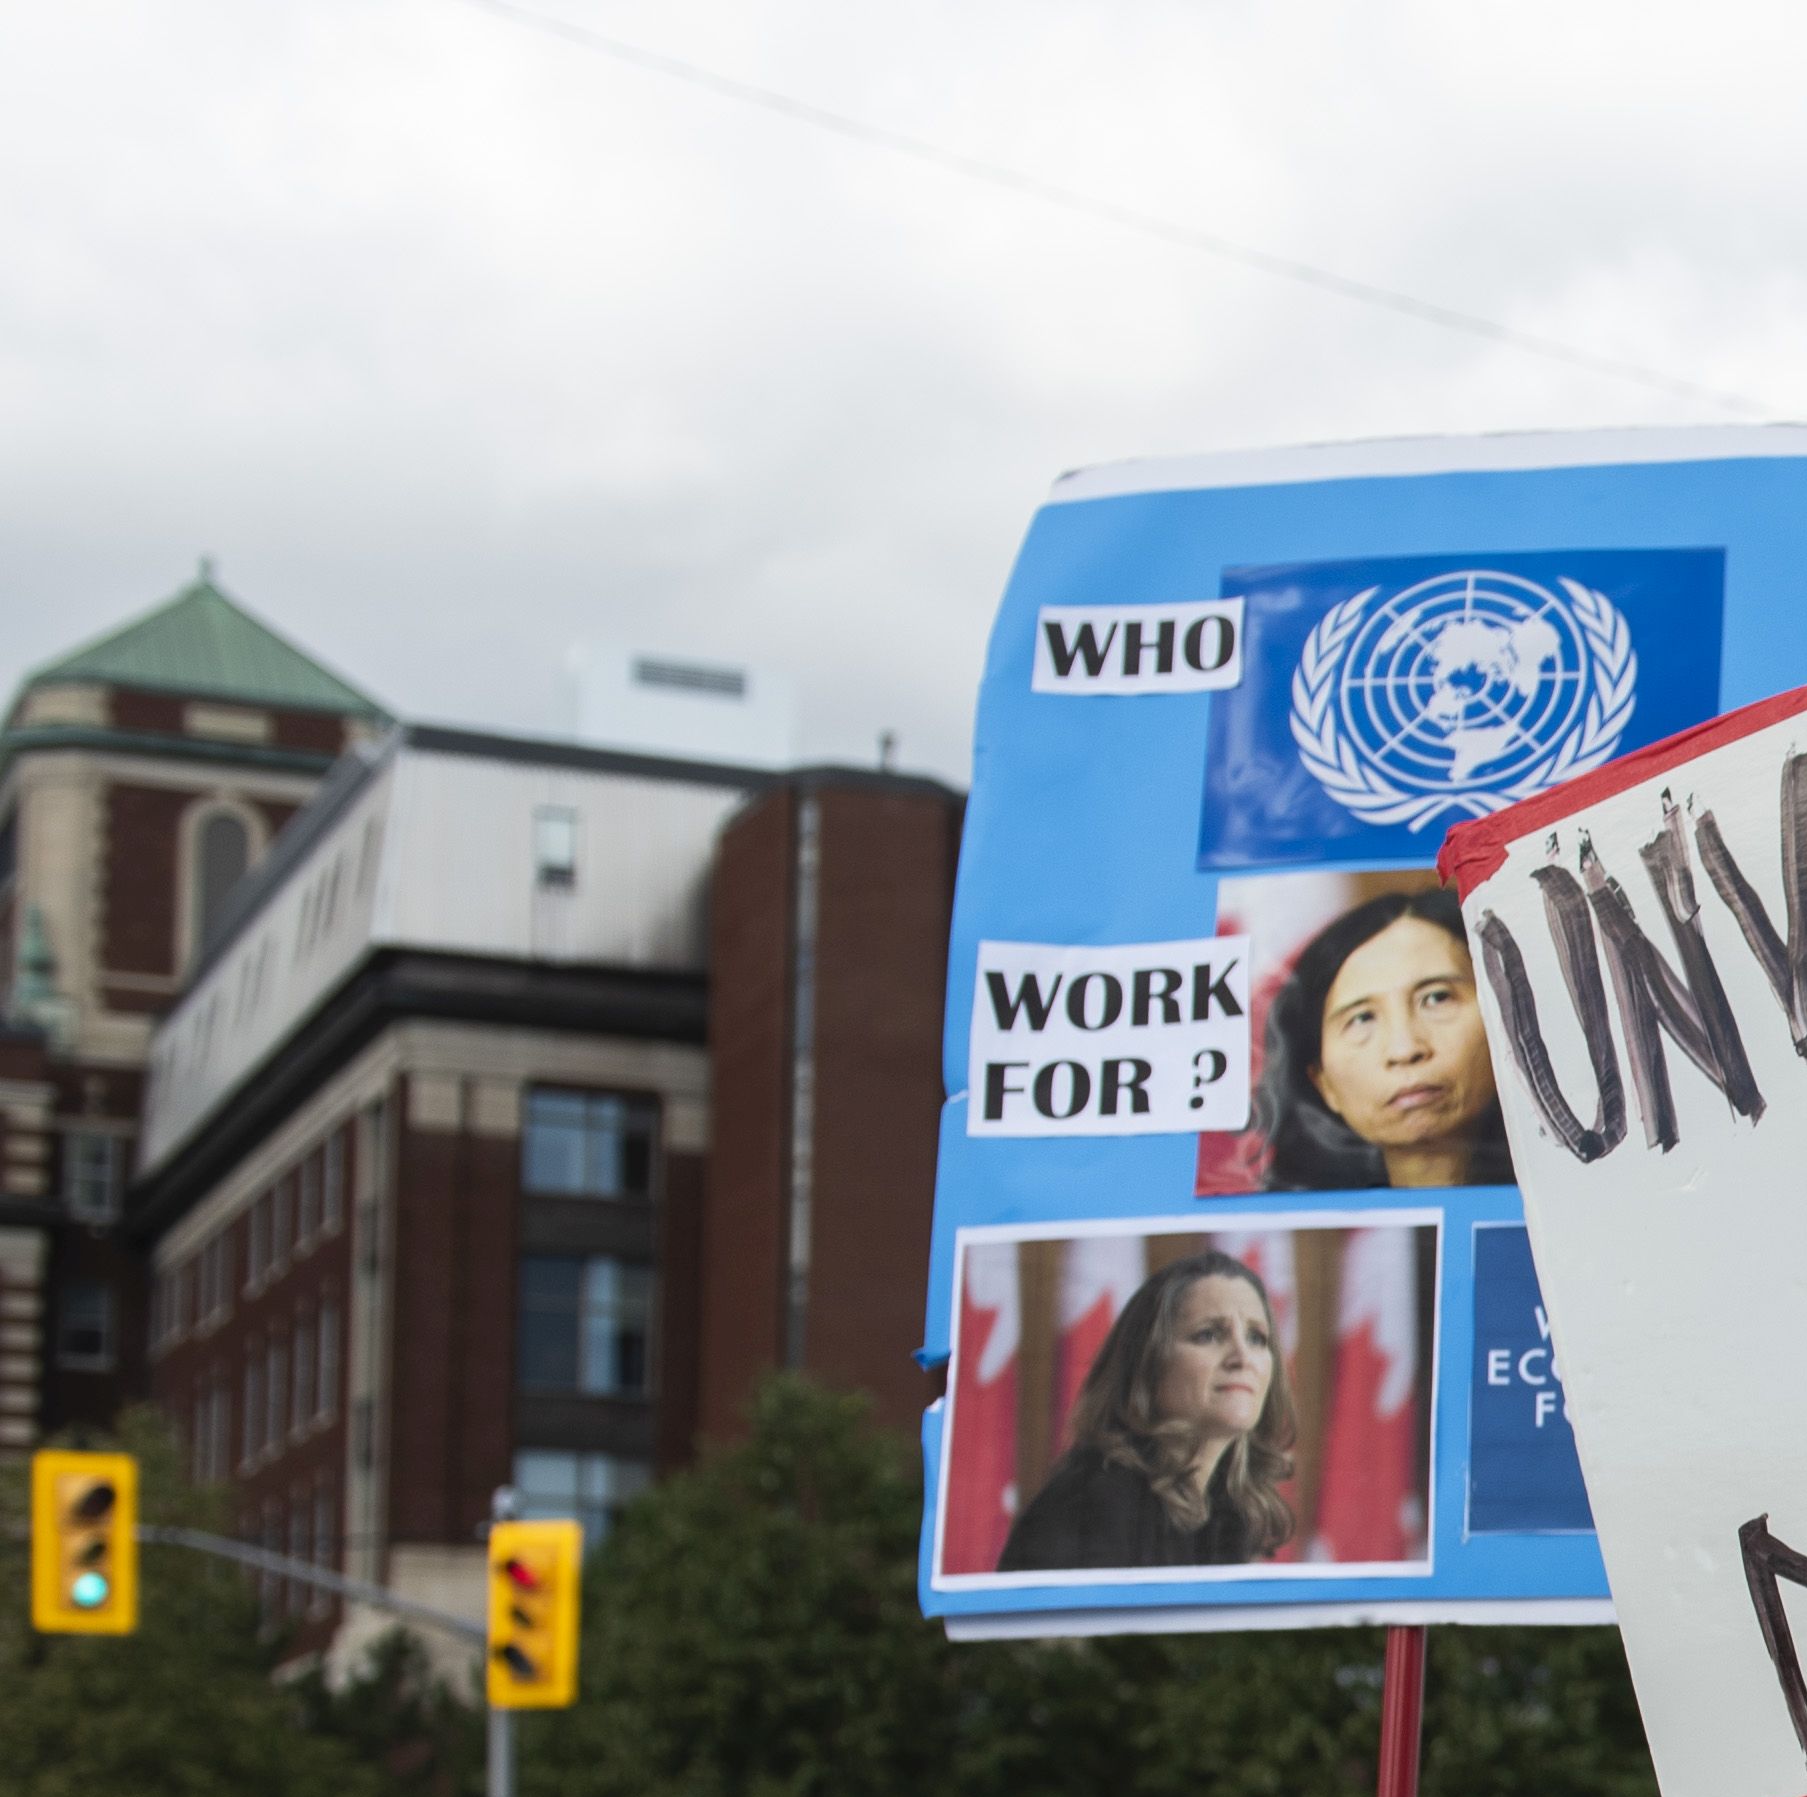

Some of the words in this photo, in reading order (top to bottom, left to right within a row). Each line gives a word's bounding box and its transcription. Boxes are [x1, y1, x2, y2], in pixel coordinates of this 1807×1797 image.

[1043, 614, 1236, 678] WHO
[984, 958, 1245, 1034] WORK
[983, 1057, 1152, 1121] FOR
